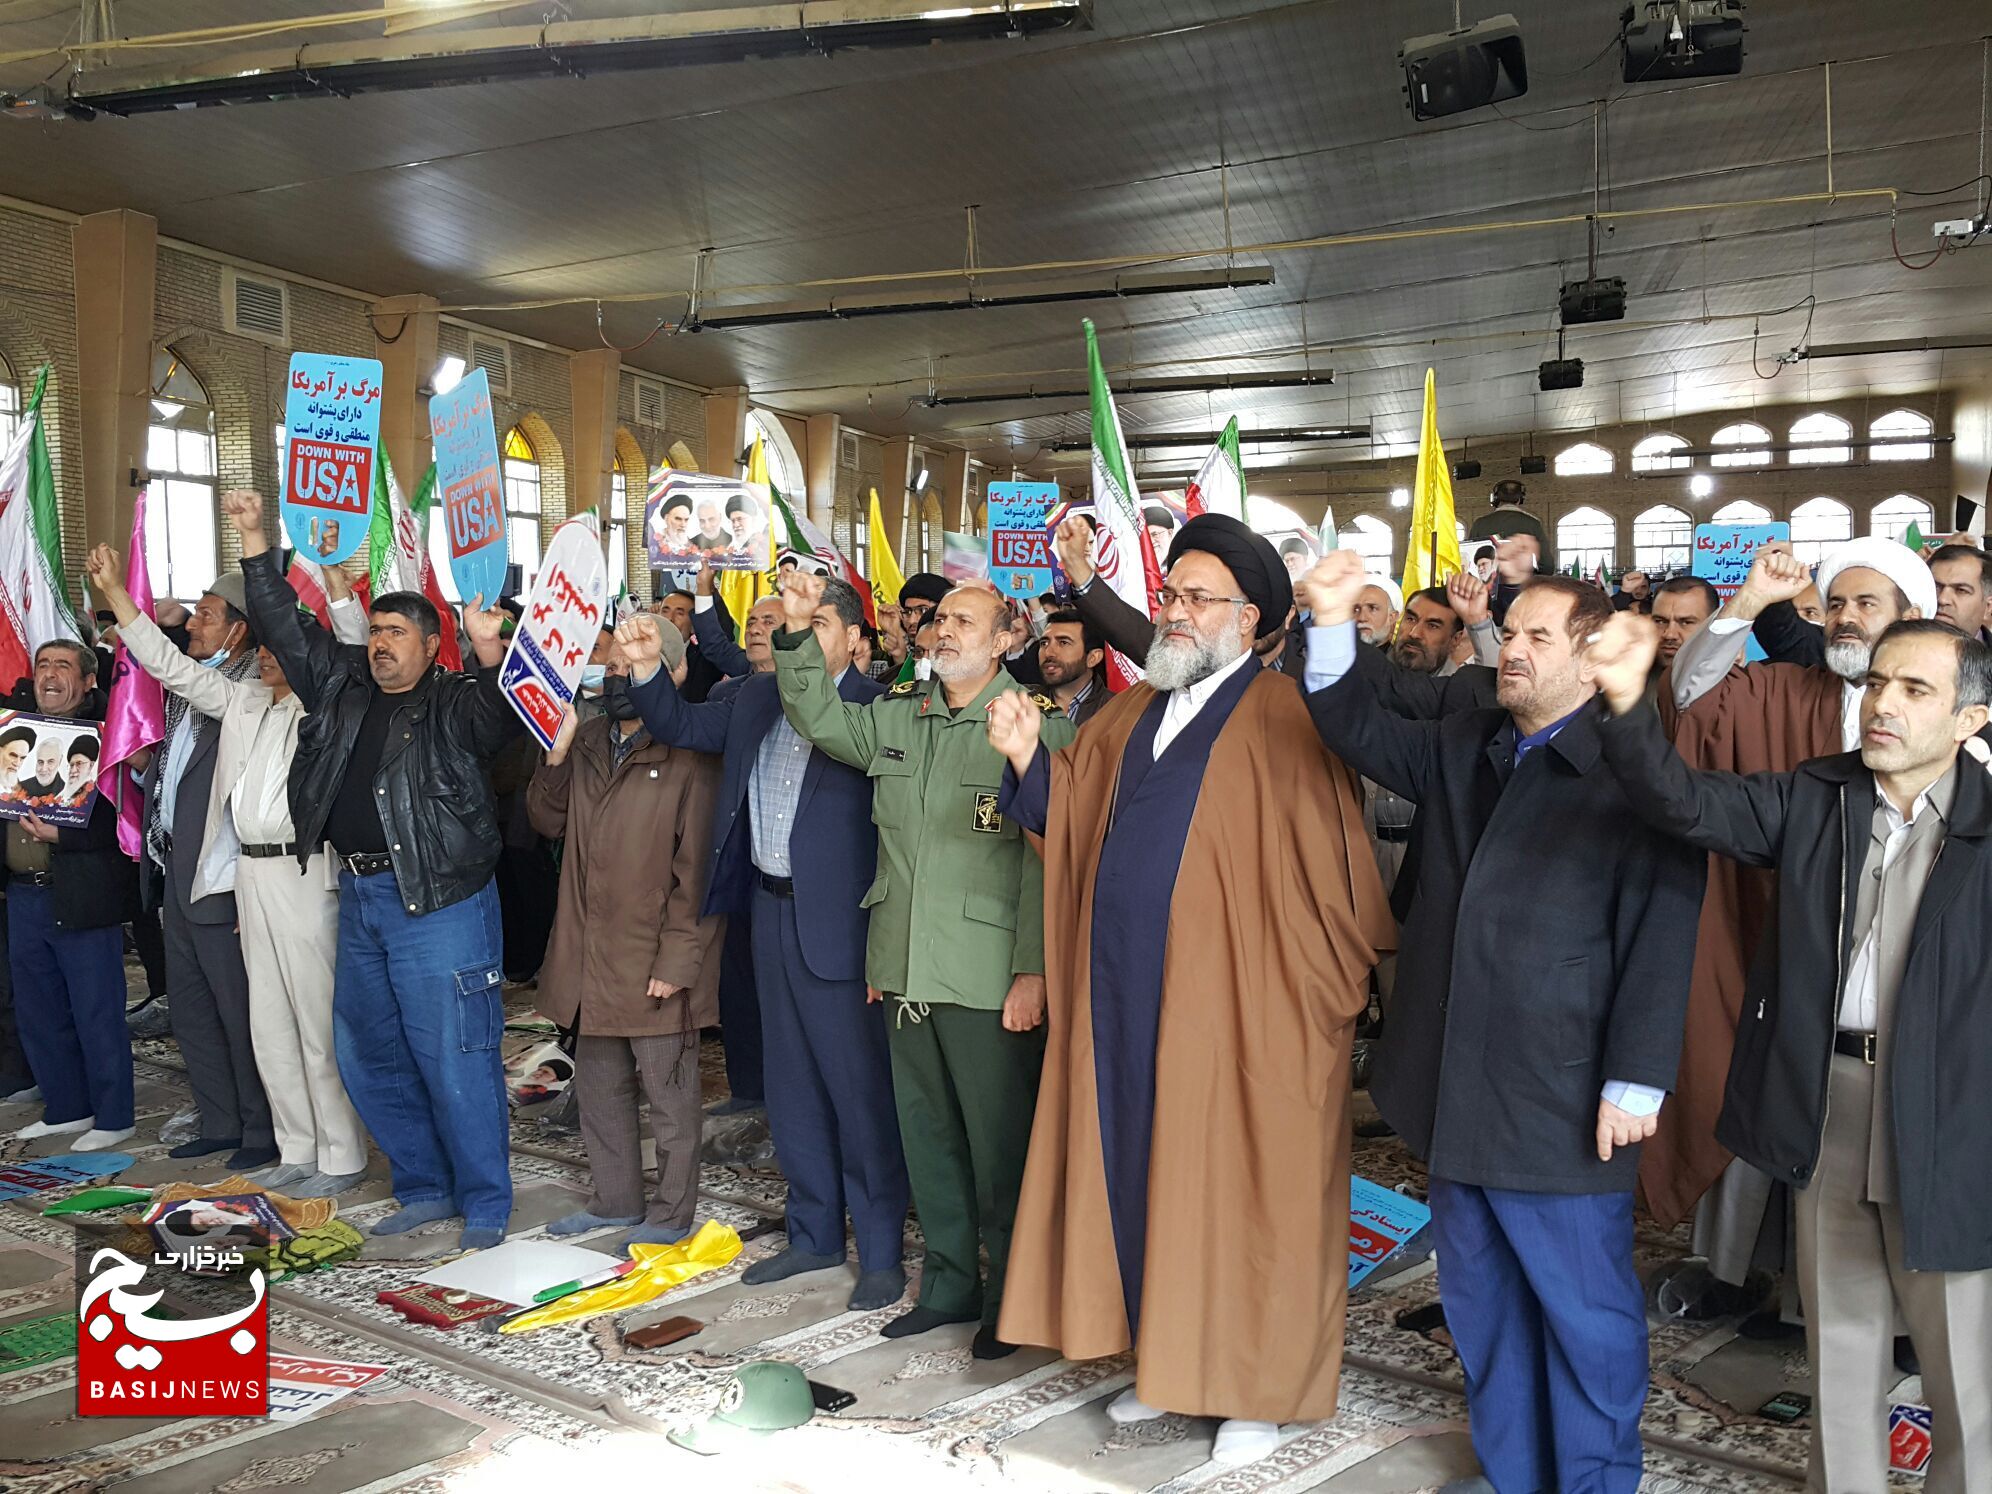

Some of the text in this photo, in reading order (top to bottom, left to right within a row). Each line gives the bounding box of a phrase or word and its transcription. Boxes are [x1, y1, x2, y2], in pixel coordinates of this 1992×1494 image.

[292, 370, 380, 404] مرگ بر آمریکا
[308, 401, 362, 422] دارای پشتوانه
[294, 422, 370, 442] منطقی و قوی است
[297, 444, 365, 464] DOWN WITH
[295, 457, 361, 507] USA
[450, 484, 473, 503] DOWN
[990, 491, 1022, 506] آمریکا
[1023, 496, 1032, 507] بر
[452, 490, 500, 548] USA
[995, 519, 1009, 527] است
[1011, 520, 1025, 529] قوی
[998, 532, 1024, 540] DOWN
[1697, 534, 1741, 554] آمریکا
[997, 541, 1048, 565] USA
[1740, 539, 1753, 554] بر
[1714, 557, 1743, 568] پشتوانه
[1722, 571, 1740, 583] قوی
[546, 562, 598, 626] انگلیس
[563, 641, 584, 667] بر
